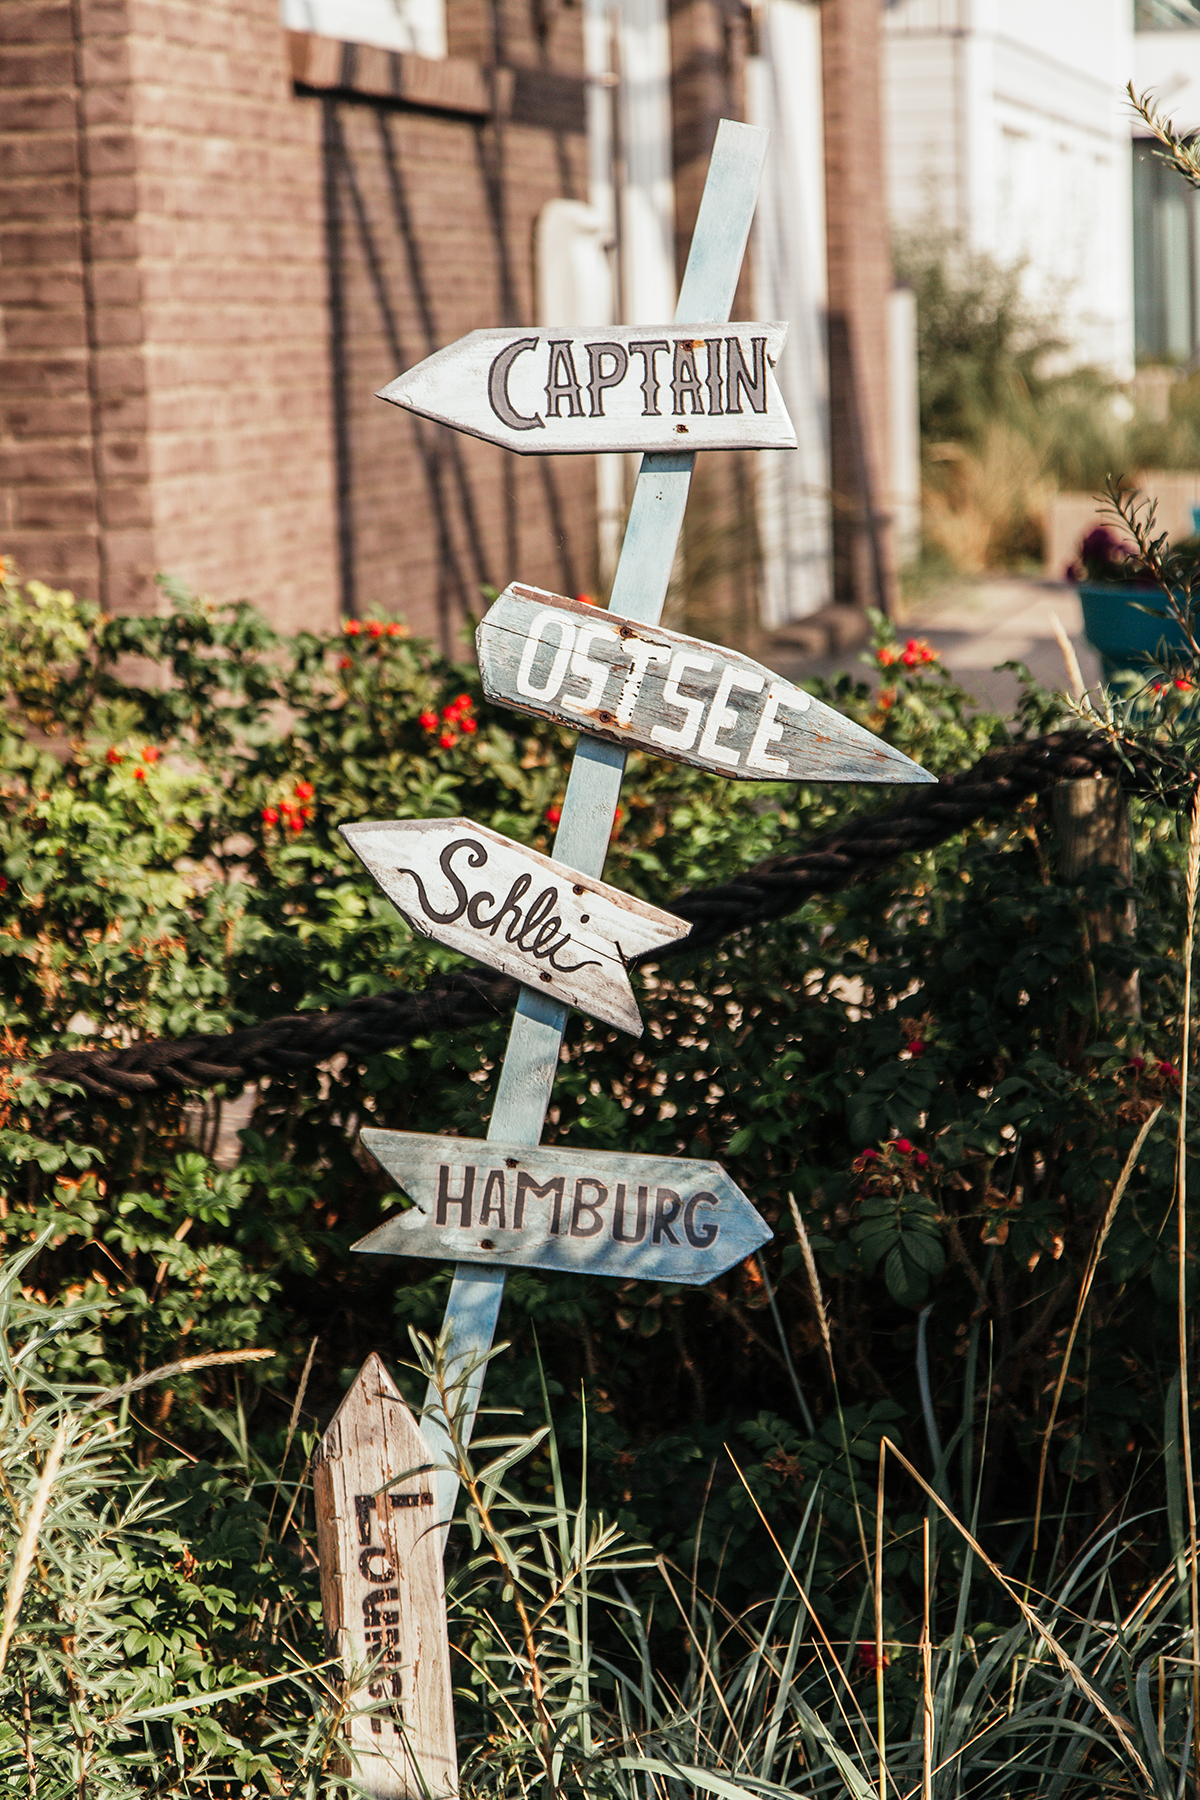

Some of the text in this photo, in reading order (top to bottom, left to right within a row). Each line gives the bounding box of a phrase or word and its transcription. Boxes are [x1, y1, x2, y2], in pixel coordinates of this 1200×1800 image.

[487, 336, 768, 431] CAPTAIN
[516, 610, 811, 775] OSTSEE
[397, 838, 603, 973] Schlei
[435, 1164, 720, 1249] HAMBURG
